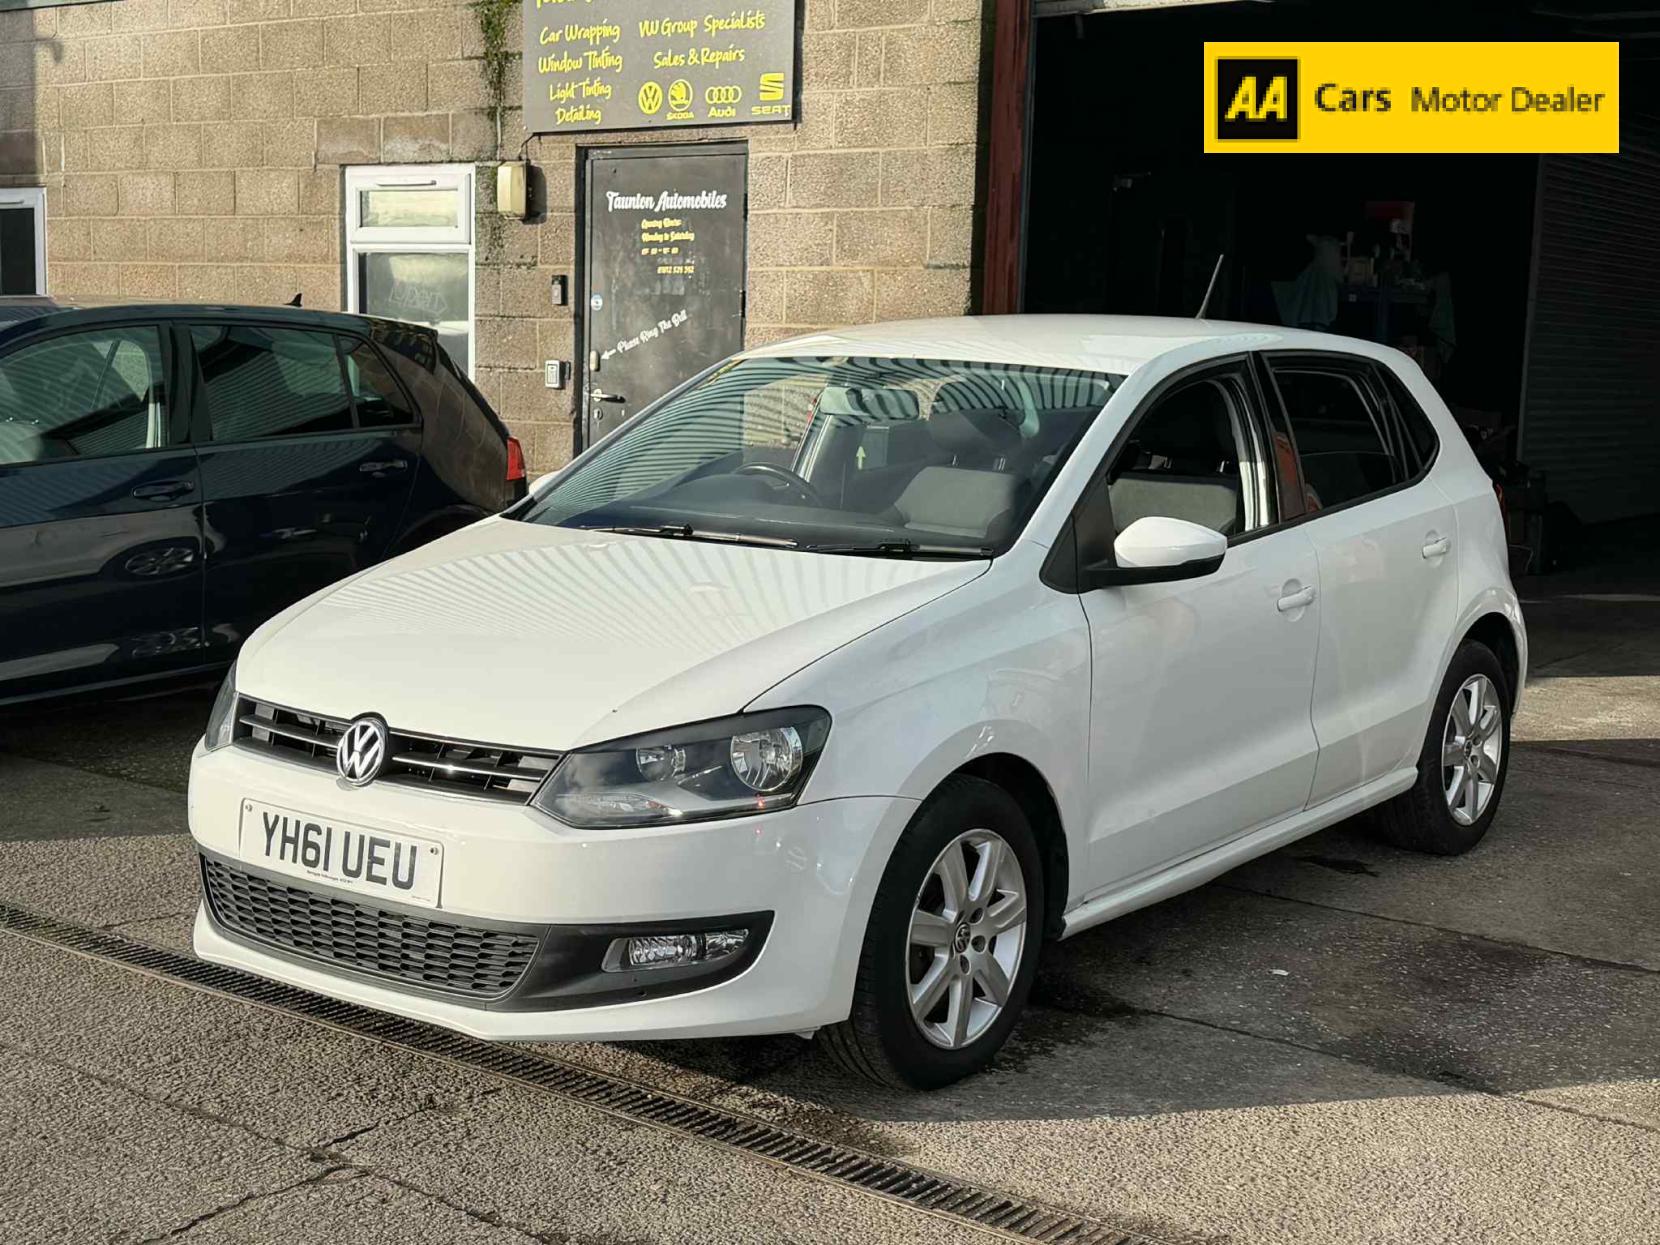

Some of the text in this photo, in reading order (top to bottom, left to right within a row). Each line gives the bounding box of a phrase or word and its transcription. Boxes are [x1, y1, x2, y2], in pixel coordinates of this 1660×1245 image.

[540, 18, 620, 45] Car Wrapping
[639, 10, 765, 38] VW Group Specialists
[538, 46, 622, 73] Window Tinting
[654, 44, 745, 69] Sales & Repairs
[549, 77, 612, 104] Light Tinting
[555, 104, 601, 125] Detailing
[708, 107, 736, 118] Audi
[751, 104, 791, 116] SEAT
[606, 189, 727, 212] Taunton Automobiles
[640, 327, 659, 343] Ring
[658, 319, 673, 333] The
[671, 308, 688, 327] Bell
[263, 812, 417, 890] YH61 UEU
